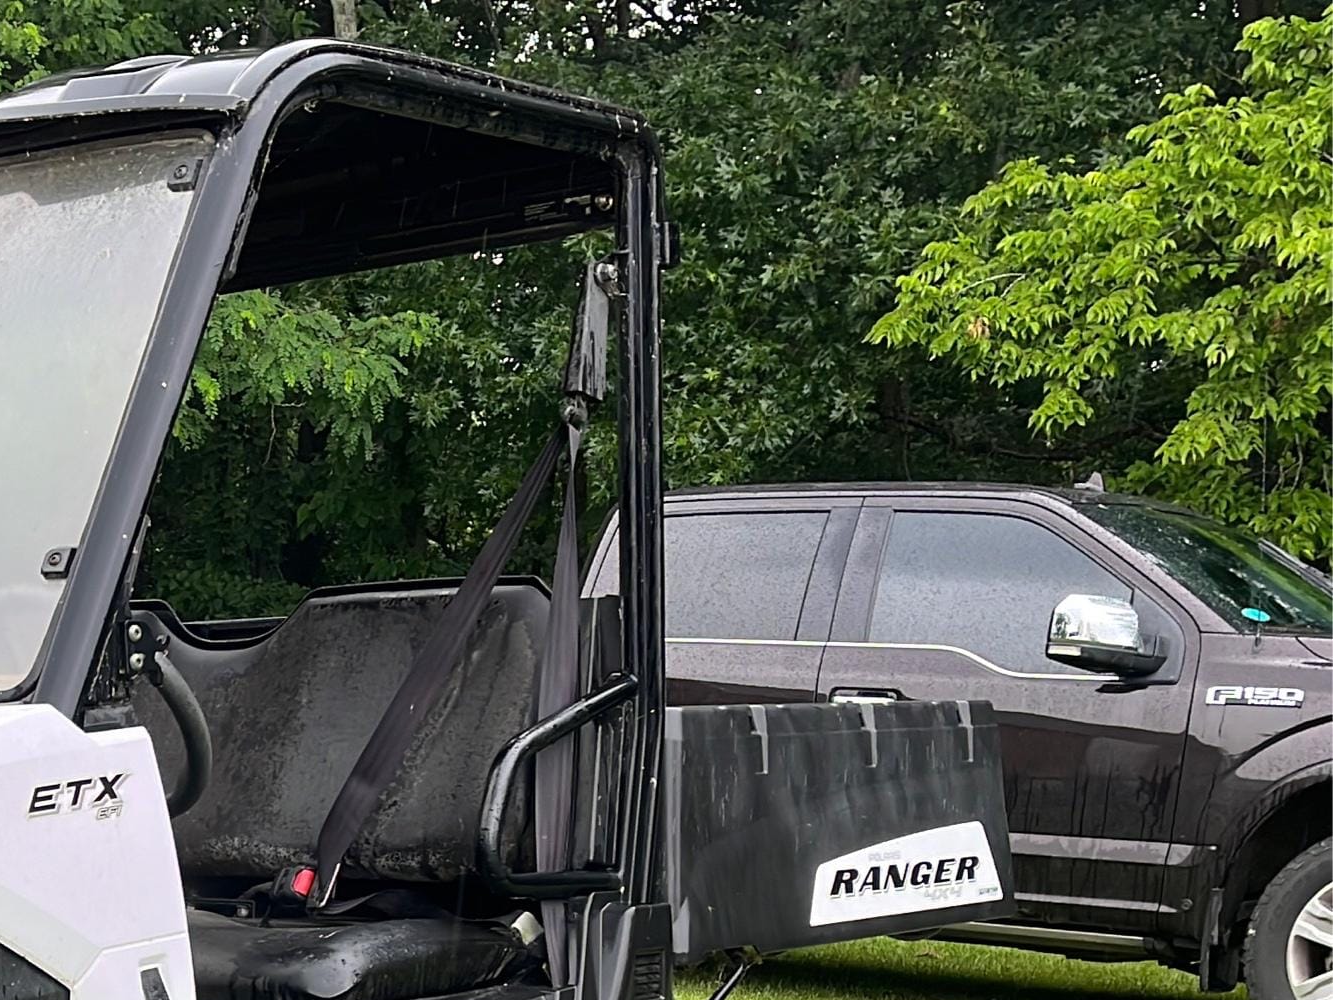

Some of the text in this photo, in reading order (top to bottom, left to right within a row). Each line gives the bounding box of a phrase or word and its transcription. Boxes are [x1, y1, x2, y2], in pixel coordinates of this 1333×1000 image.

[27, 772, 127, 816] ETX
[96, 805, 123, 820] EFI
[829, 856, 979, 897] RANGER
